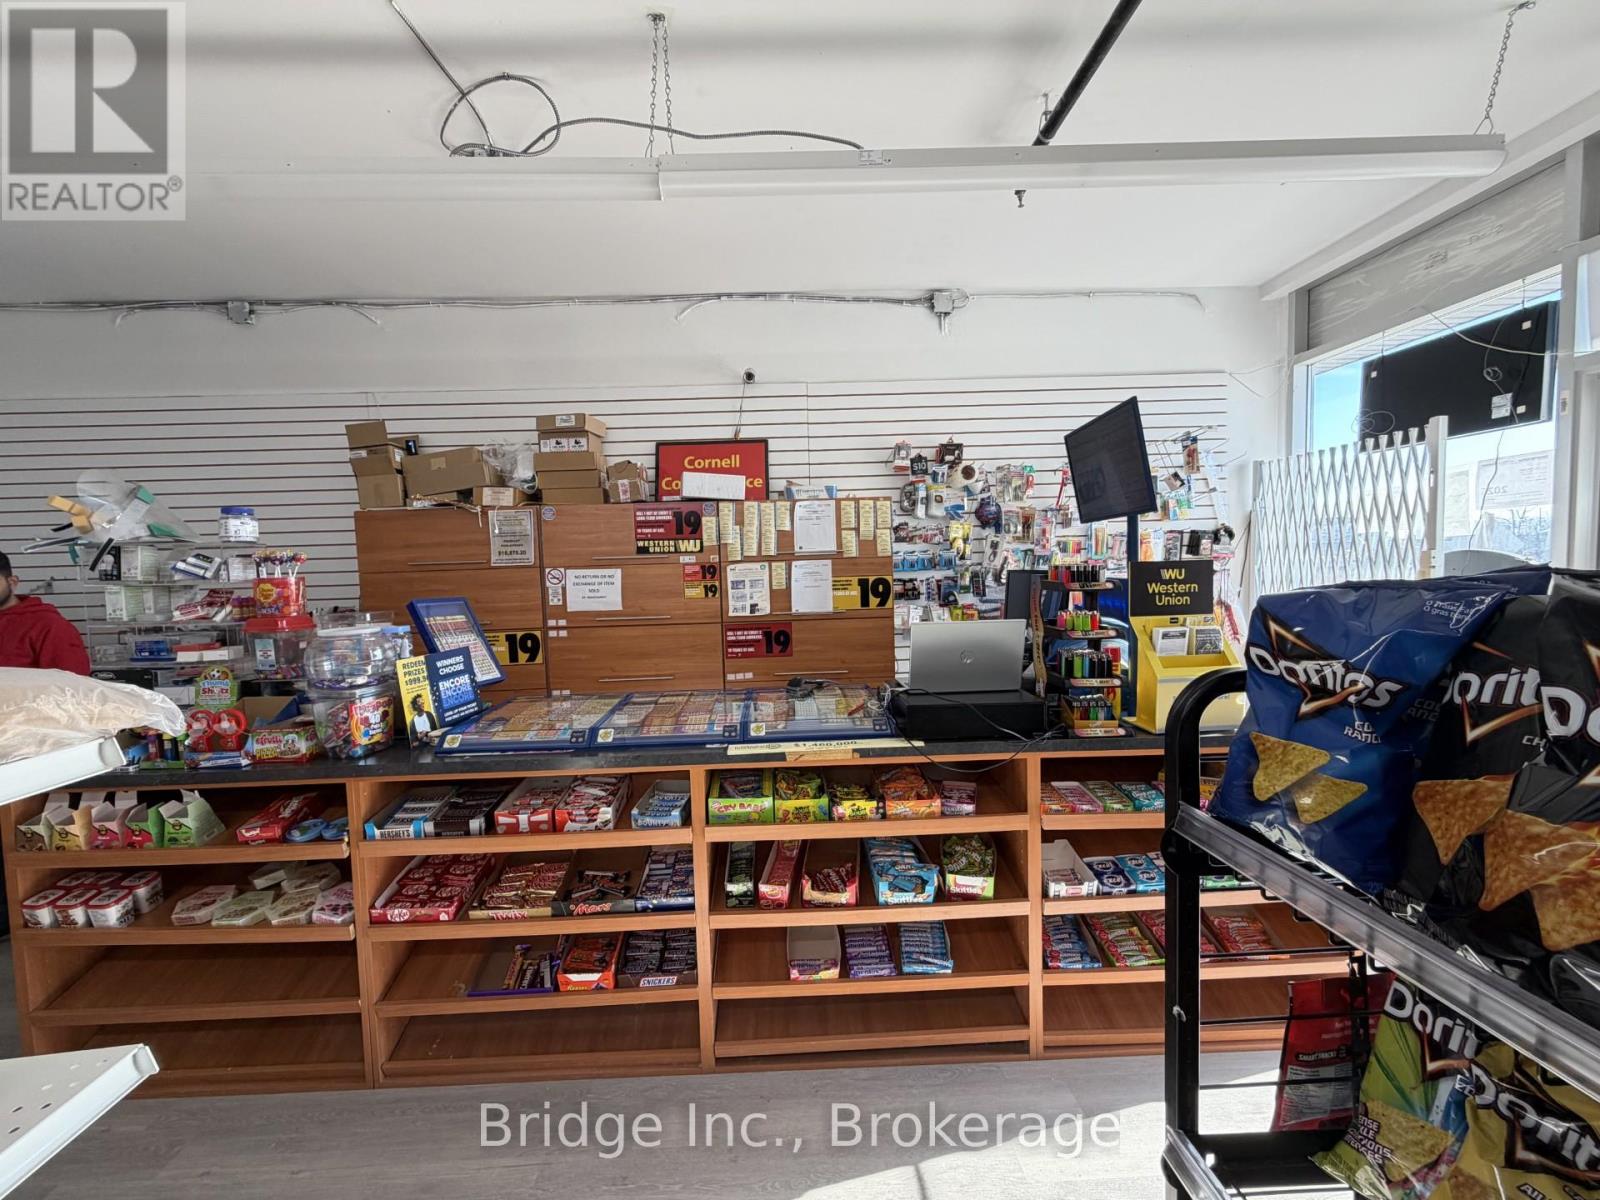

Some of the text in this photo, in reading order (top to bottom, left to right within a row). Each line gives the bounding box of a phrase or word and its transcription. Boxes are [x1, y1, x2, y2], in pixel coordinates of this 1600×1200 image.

[684, 454, 740, 469] Cornell
[673, 510, 701, 535] 19
[700, 564, 717, 580] 19
[1160, 568, 1185, 580] WU
[703, 583, 718, 598] 19
[857, 576, 892, 608] 19
[1146, 583, 1199, 594] Western
[1155, 593, 1191, 606] Union
[505, 632, 541, 663] 19
[762, 629, 791, 654] 19
[436, 655, 464, 669] WINNERS
[439, 663, 465, 675] CHOOSE
[403, 667, 425, 678] PRIZES
[1250, 646, 1405, 708] Doritos
[439, 674, 471, 690] ENCORE
[380, 828, 411, 838] HERSHEY'S
[489, 911, 528, 920] Twix
[573, 902, 612, 917] Mars
[640, 976, 676, 987] SNICKERS
[1383, 980, 1480, 1059] Dorit
[1471, 1063, 1600, 1171] Dorit
